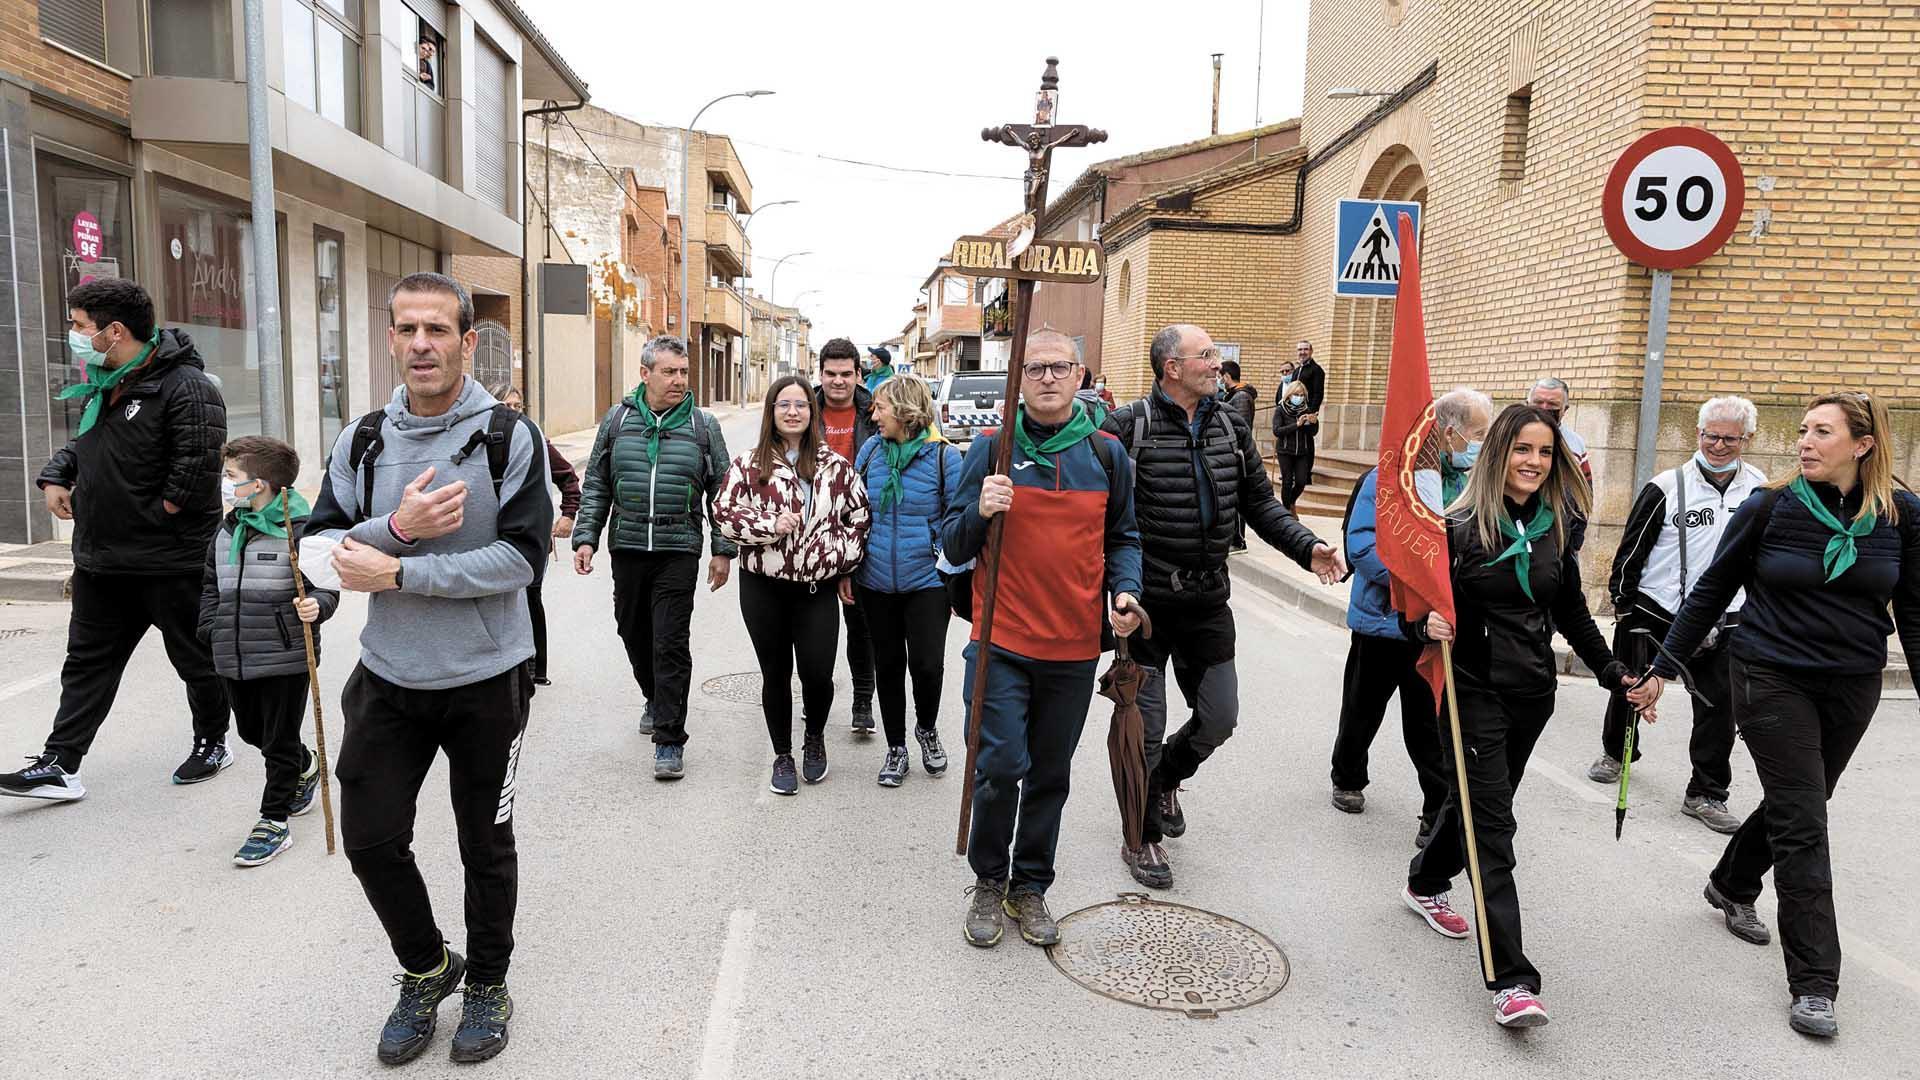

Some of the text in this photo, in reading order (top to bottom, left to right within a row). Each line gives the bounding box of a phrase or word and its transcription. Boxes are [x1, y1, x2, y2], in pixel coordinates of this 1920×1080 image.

[1634, 175, 1714, 222] 50
[77, 219, 98, 230] LAVAR
[77, 231, 99, 243] PEINAR
[81, 241, 97, 258] 9€
